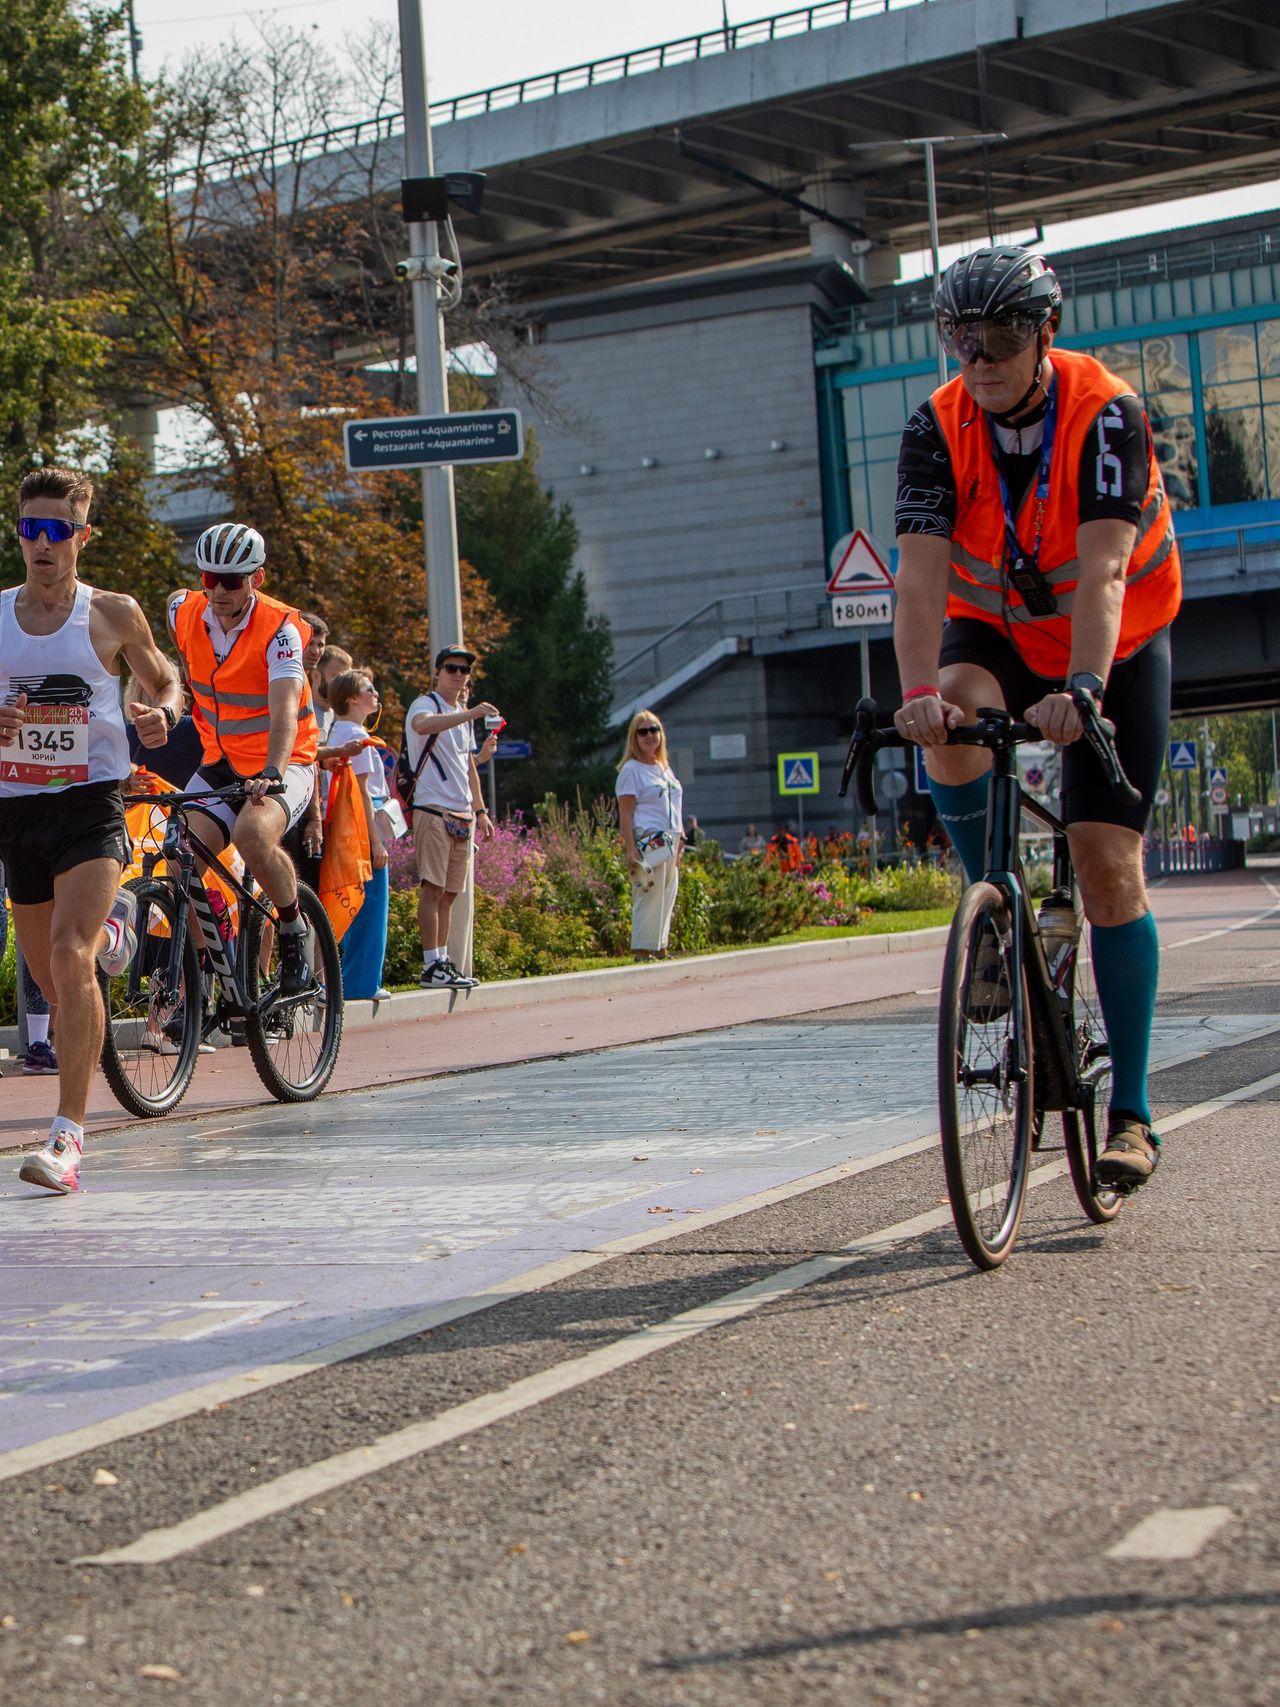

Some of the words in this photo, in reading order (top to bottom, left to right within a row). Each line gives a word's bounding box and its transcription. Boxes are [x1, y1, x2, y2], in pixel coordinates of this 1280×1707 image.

[372, 428, 420, 440] Ресторан
[421, 422, 494, 436] «Aquamarine»
[373, 441, 425, 453] Restaurant
[427, 436, 495, 450] «Aquamarine»
[69, 708, 83, 716] 21,1
[18, 729, 75, 752] 1345
[32, 753, 56, 762] ЮРИЙ
[189, 876, 244, 1008] SCOTT
[322, 1013, 341, 1080] SCHWALBE
